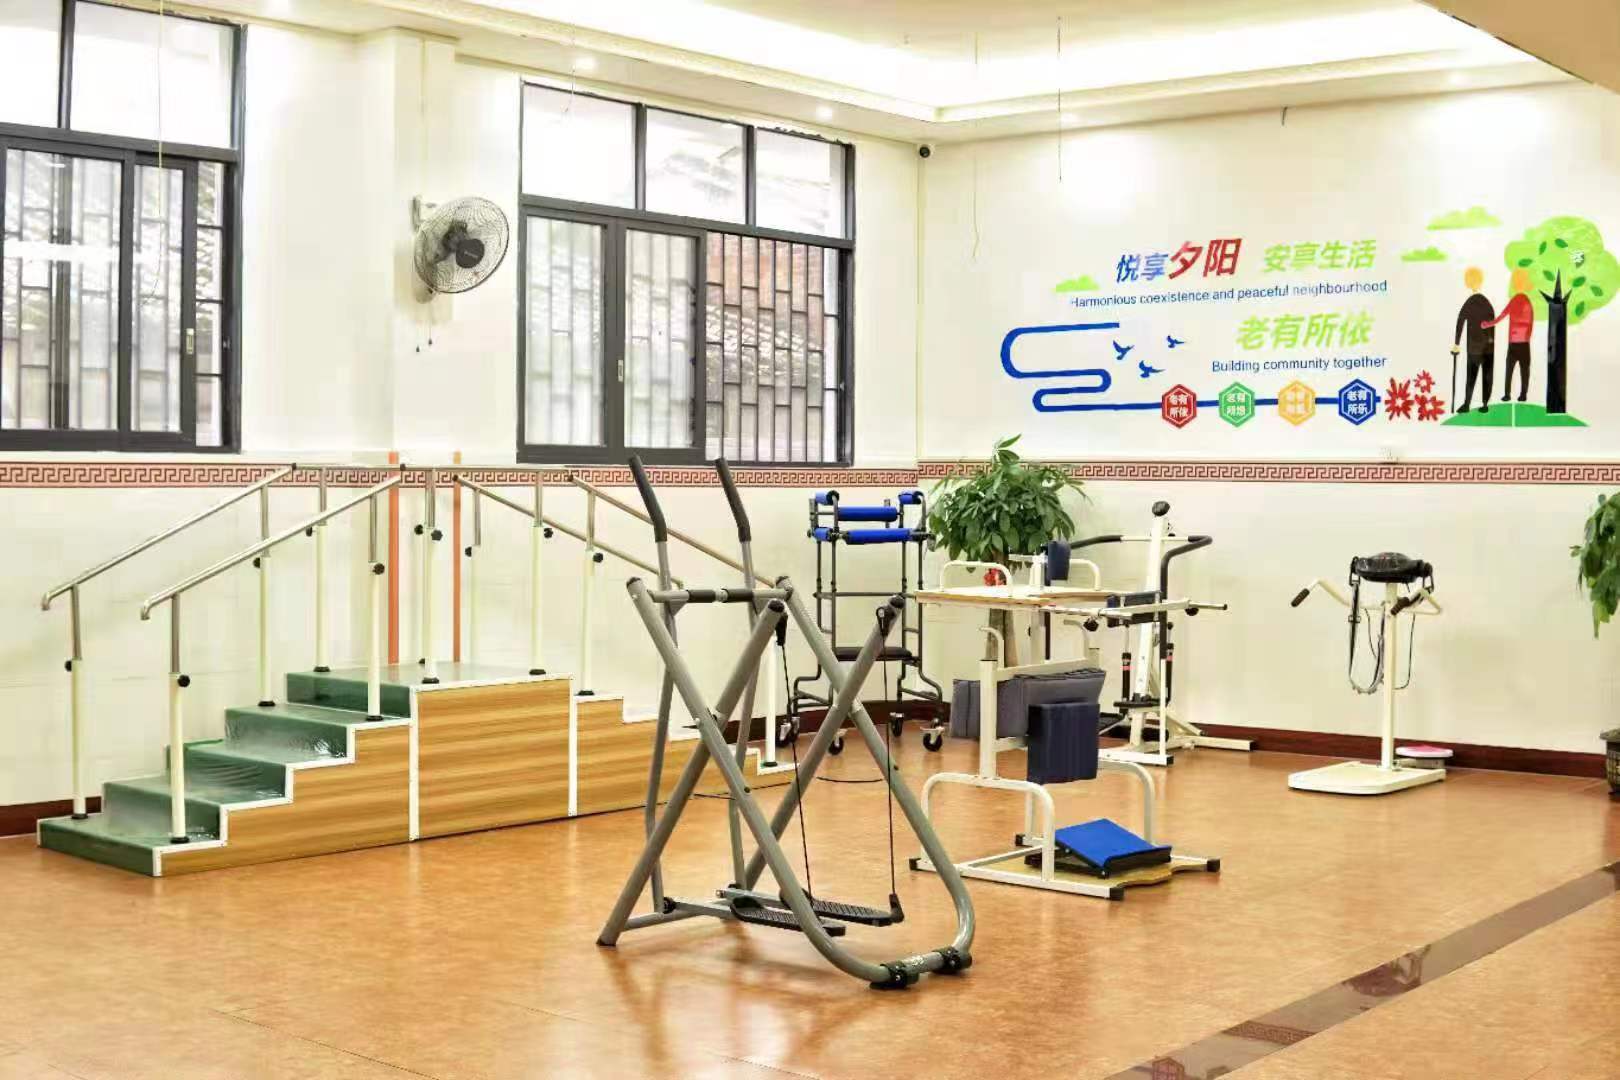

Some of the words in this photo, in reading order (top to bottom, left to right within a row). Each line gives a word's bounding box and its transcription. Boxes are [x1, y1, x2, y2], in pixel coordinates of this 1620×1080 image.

[1116, 238, 1243, 283] 悦享夕阳
[1263, 239, 1377, 273] 安享生活
[1071, 295, 1137, 307] Harmonious
[1140, 290, 1209, 304] coexistence
[1213, 288, 1234, 300] and
[1237, 284, 1289, 301] peaceful
[1292, 280, 1388, 297] neighbourhood
[1236, 311, 1374, 350] 老有所依
[1212, 360, 1260, 373] Building
[1264, 358, 1329, 371] community
[1333, 356, 1388, 369] together
